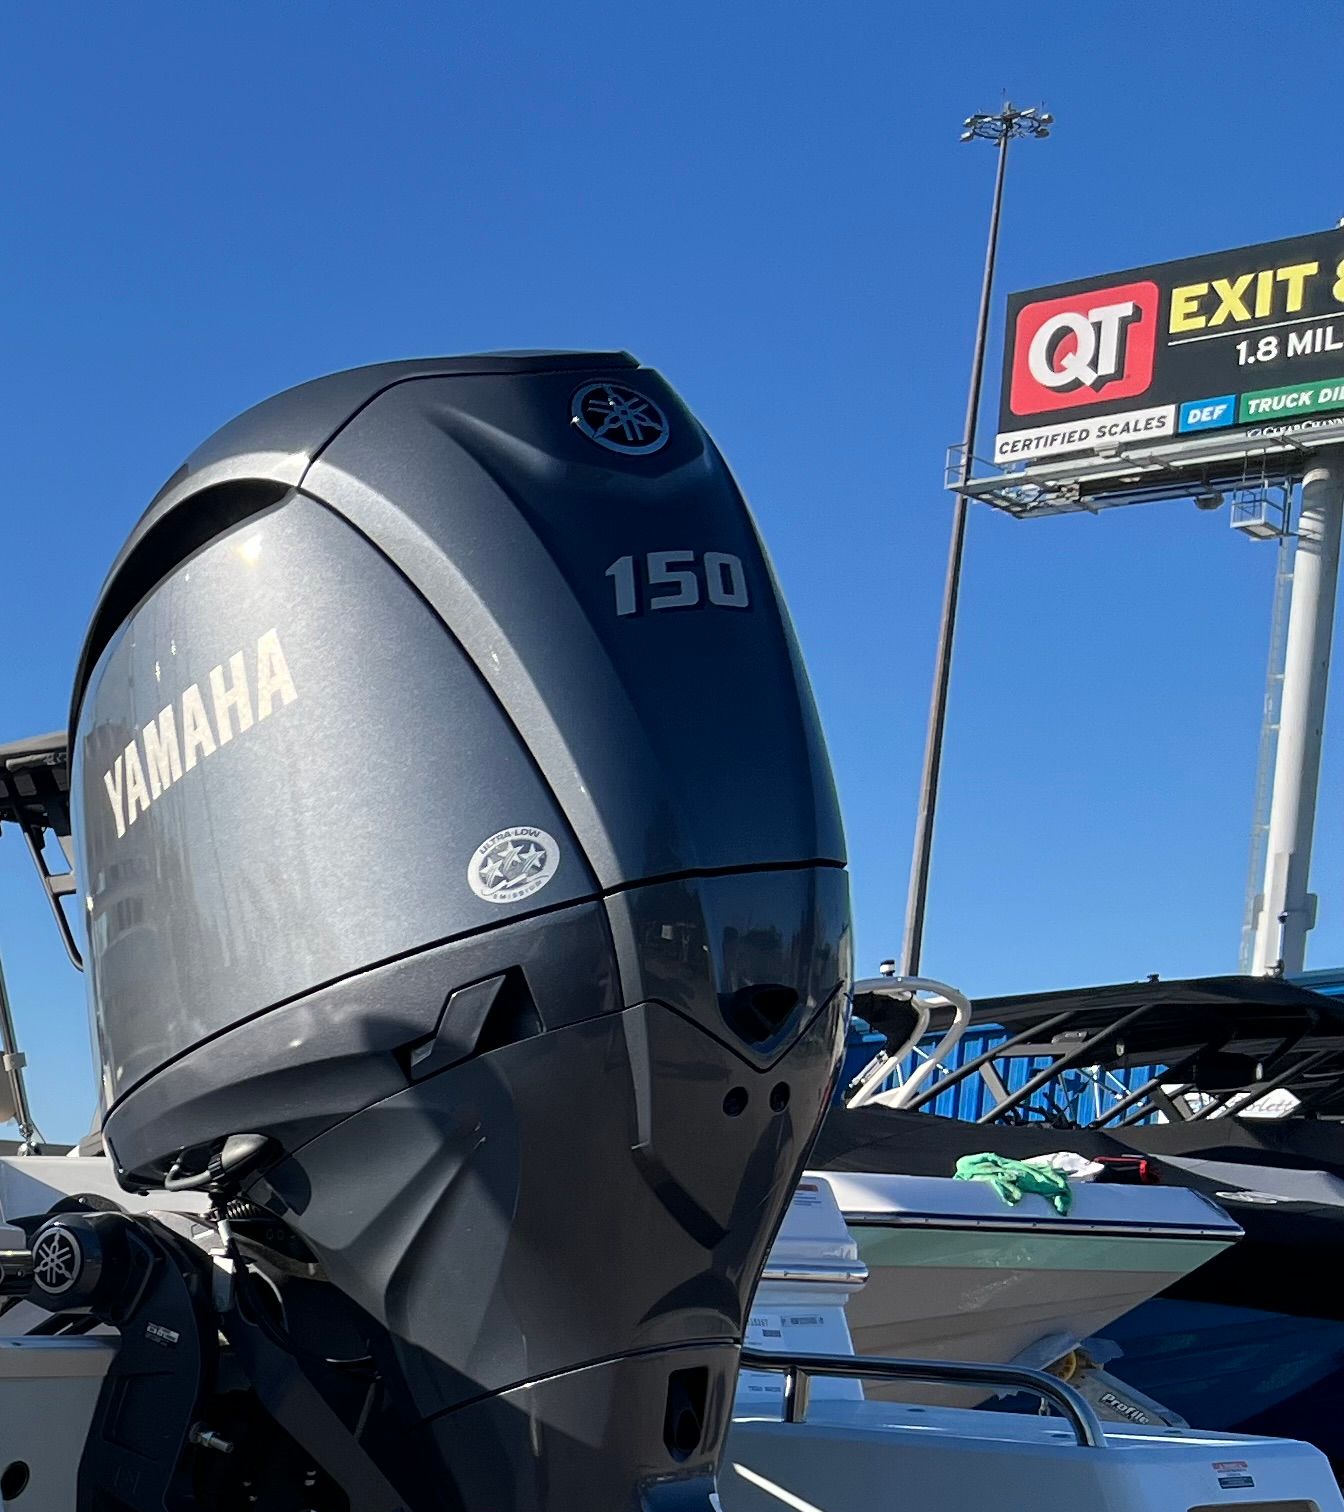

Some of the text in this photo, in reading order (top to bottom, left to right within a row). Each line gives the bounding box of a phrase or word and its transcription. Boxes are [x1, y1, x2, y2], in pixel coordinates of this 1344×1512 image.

[1169, 261, 1320, 334] EXIT
[1028, 301, 1134, 387] QT
[1235, 336, 1279, 366] 1.8
[1186, 404, 1229, 425] DEF
[1247, 390, 1314, 415] TRUCK
[998, 414, 1168, 455] CERTIFIED SCALES
[606, 550, 750, 616] 150
[103, 627, 300, 840] YAMAHA
[1100, 1392, 1151, 1425] Profile
